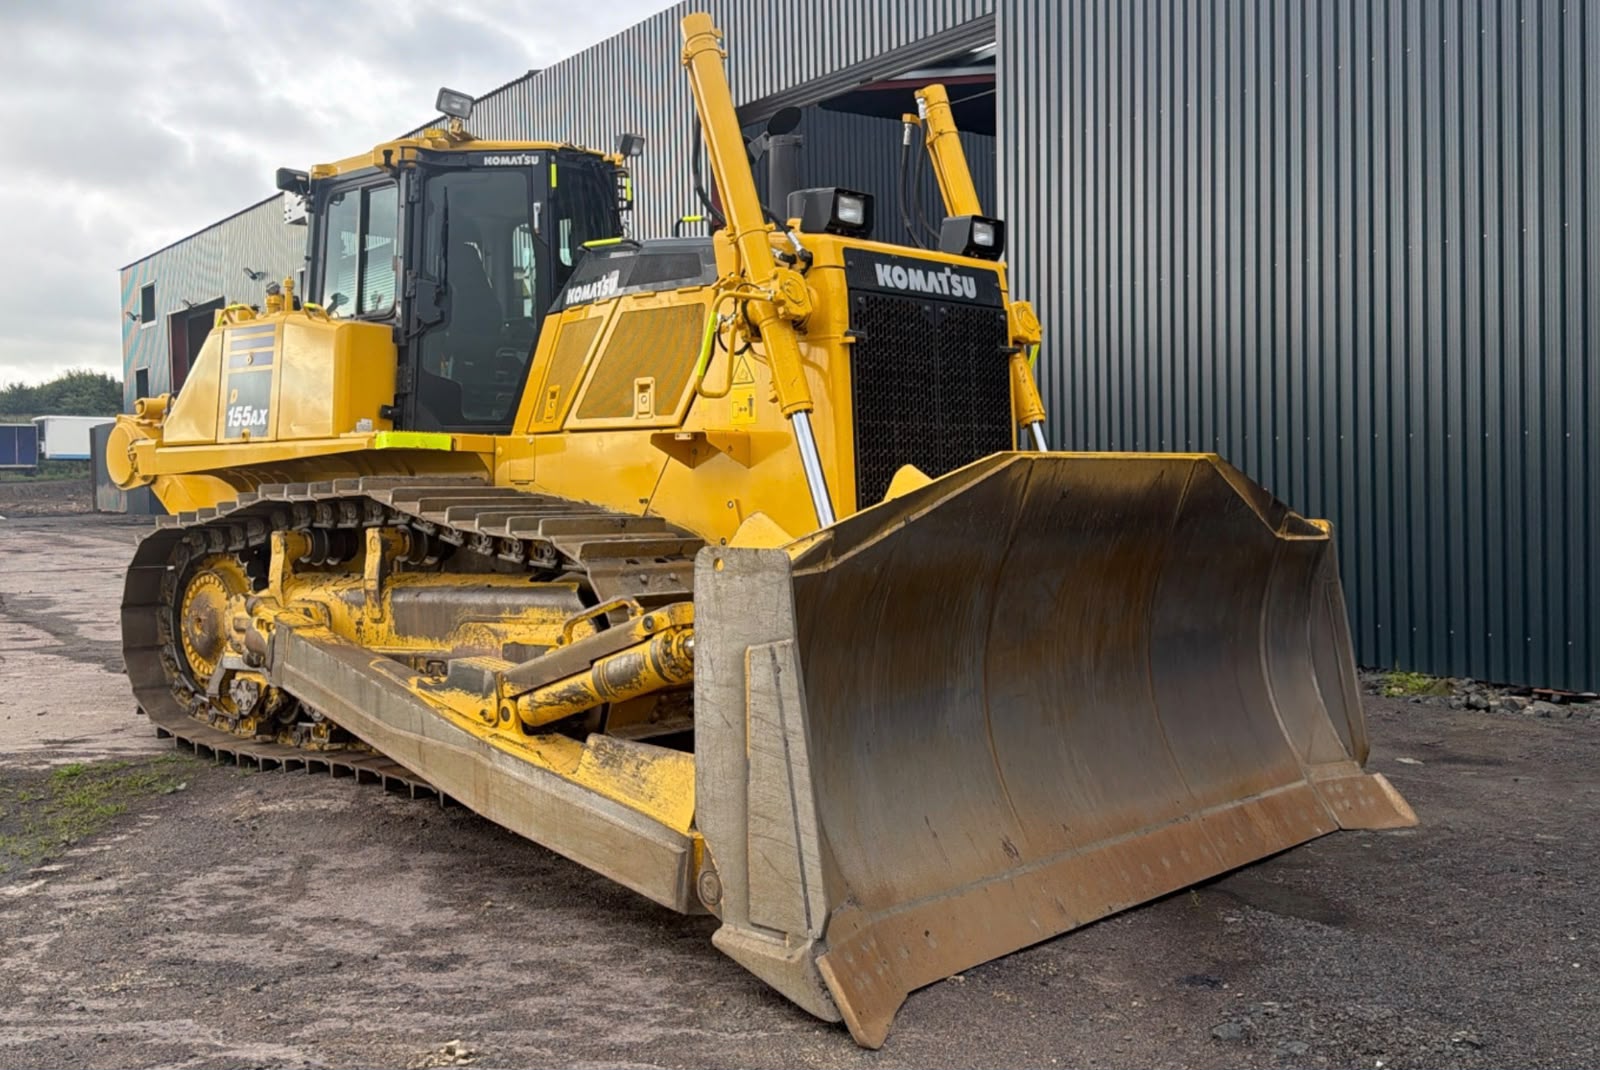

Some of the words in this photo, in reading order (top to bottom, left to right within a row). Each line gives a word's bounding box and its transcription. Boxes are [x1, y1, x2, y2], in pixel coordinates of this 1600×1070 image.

[483, 153, 539, 166] KOMATSU
[565, 273, 619, 305] KOMATSU
[874, 262, 977, 299] KOMATSU
[228, 405, 268, 427] 155AX
